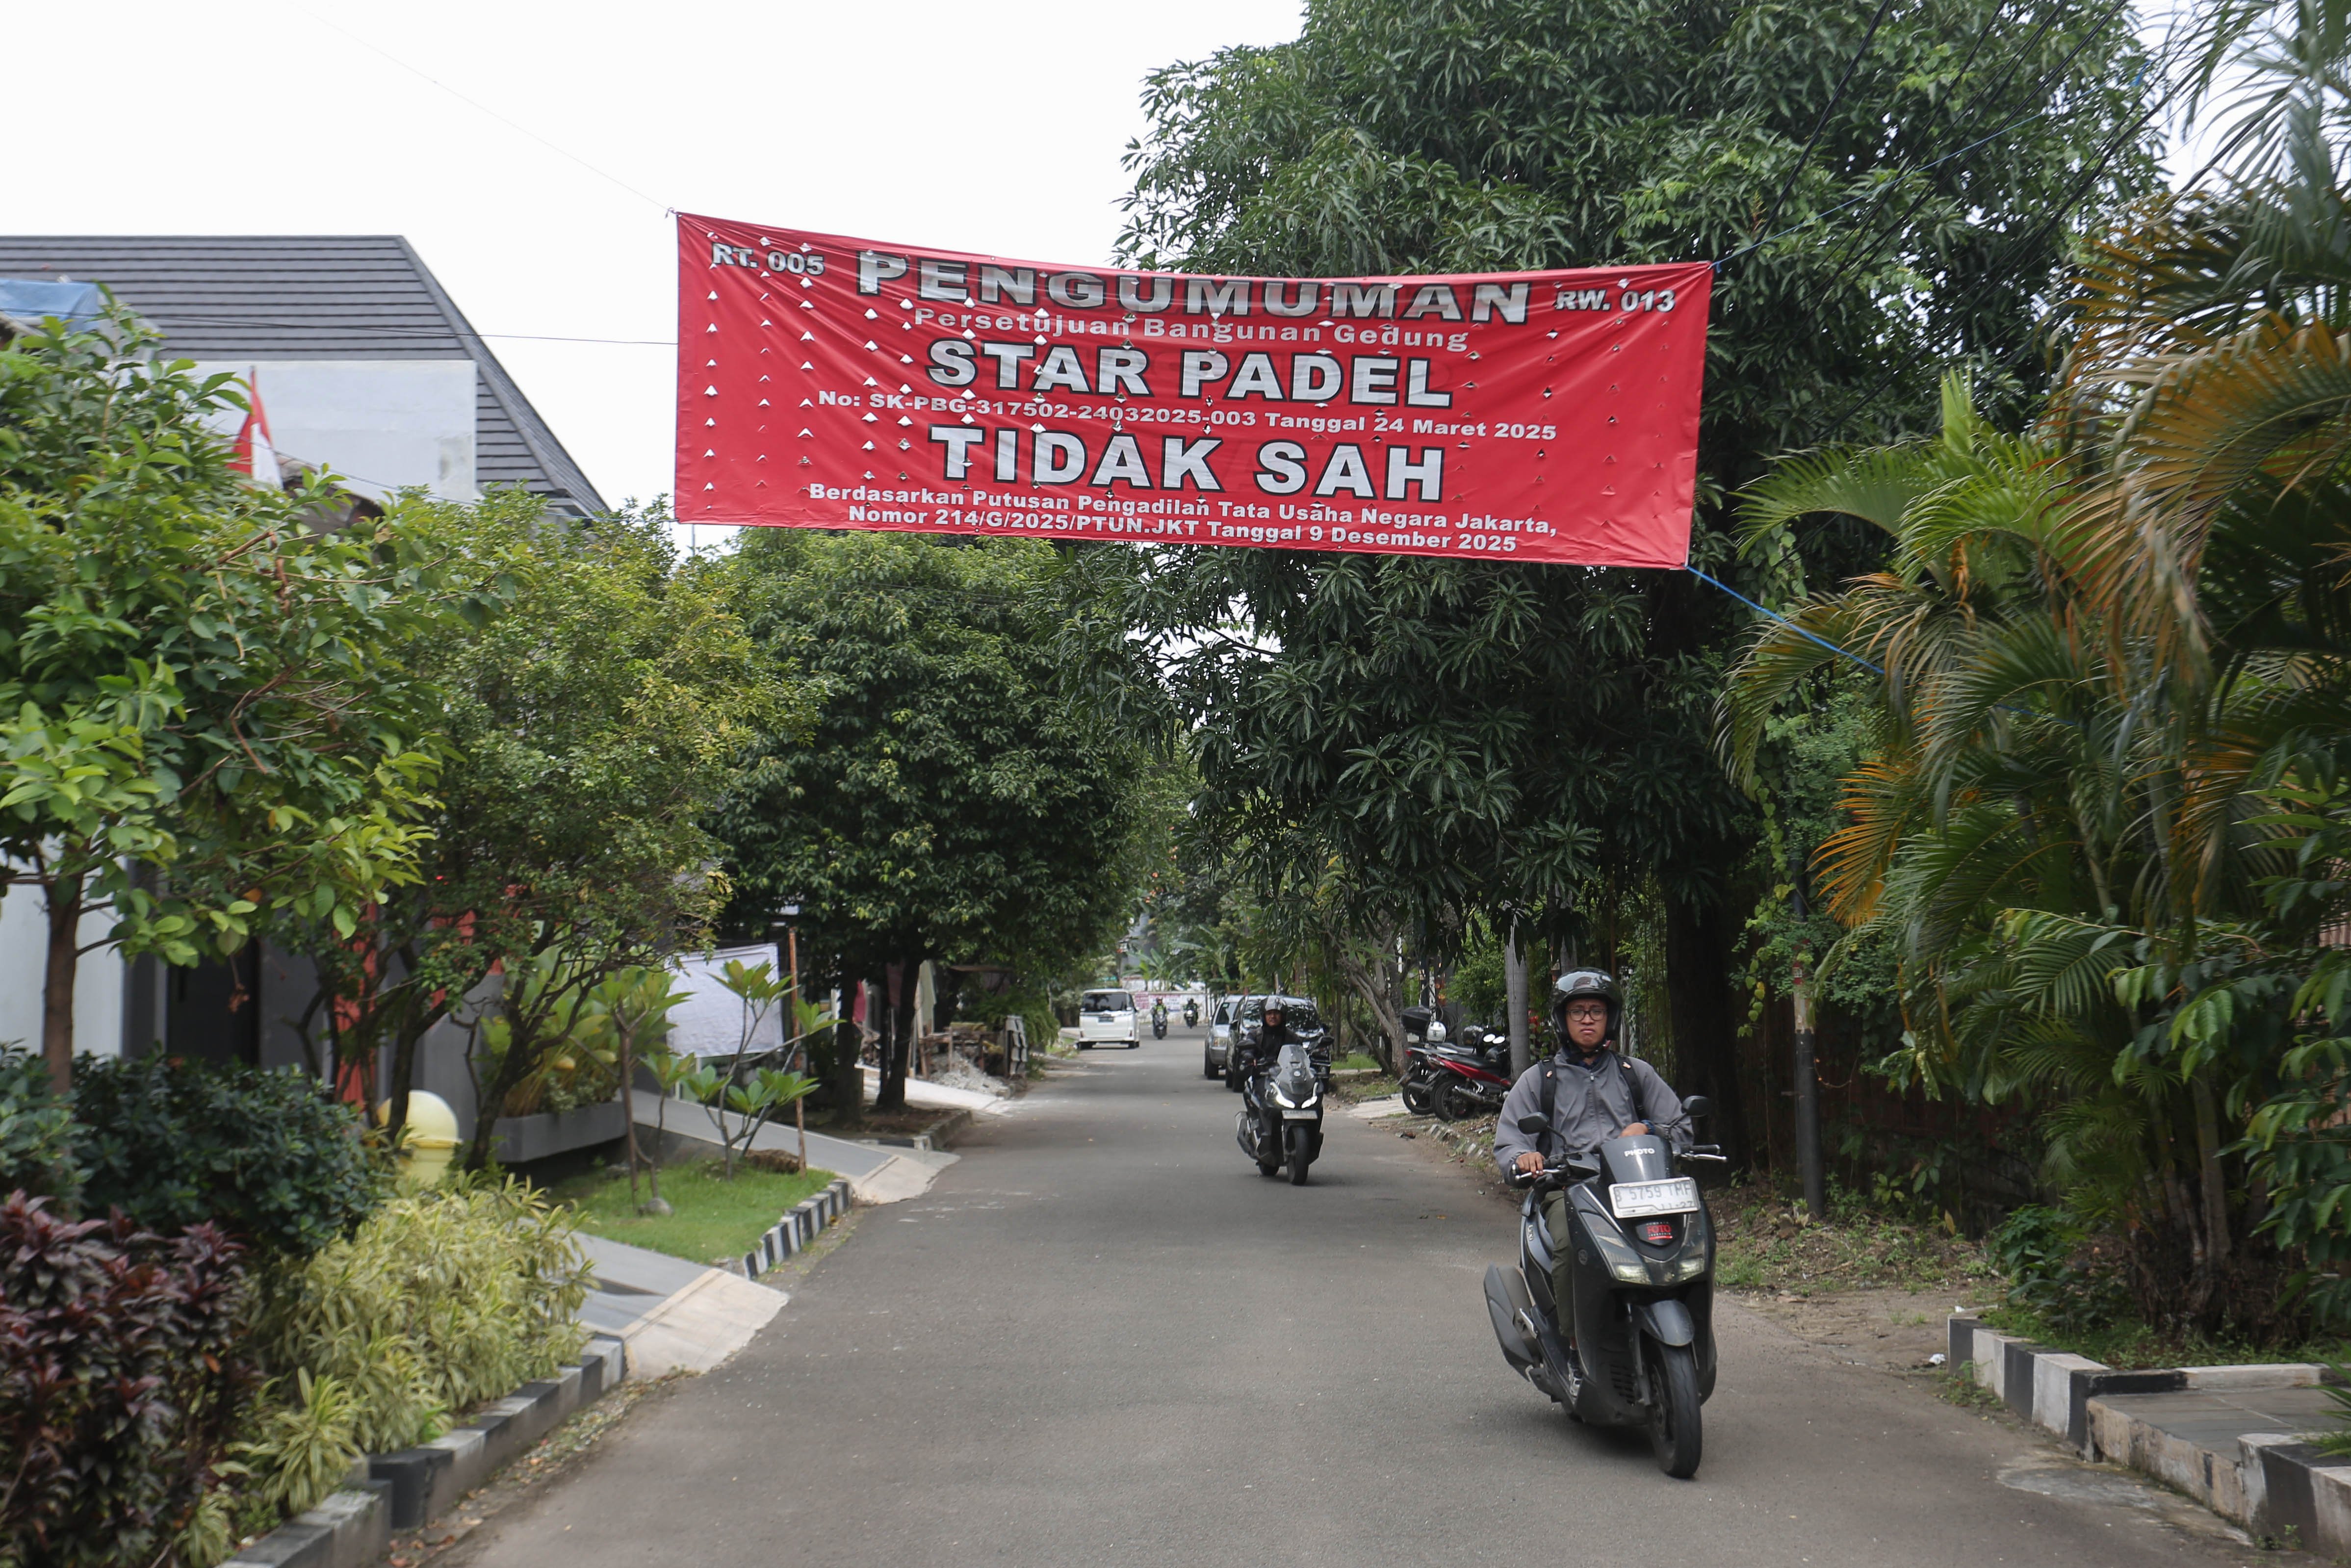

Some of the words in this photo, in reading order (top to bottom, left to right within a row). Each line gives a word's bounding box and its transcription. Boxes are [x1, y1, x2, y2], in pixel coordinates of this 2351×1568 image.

[712, 242, 758, 268] RT.
[767, 251, 825, 276] 005
[857, 251, 1532, 325] PENGUMUMAN
[1555, 289, 1612, 311] RW.
[1620, 288, 1676, 312] 013
[914, 308, 1130, 337] Persetujuan
[1143, 318, 1321, 343] Bangunan
[1333, 324, 1469, 352] Gedung
[925, 337, 1155, 397] STAR
[1178, 348, 1454, 409] PADEL
[818, 390, 861, 407] No:
[869, 392, 1256, 426] SK-PBG-317502-24032025-003
[1264, 412, 1365, 434] Tanggal
[1373, 417, 1404, 433] 24
[1413, 418, 1487, 437] Maret
[1494, 422, 1557, 440] 2025
[927, 423, 1226, 493] TIDAK
[1252, 438, 1446, 503] SAH
[809, 483, 964, 506] Berdasarkan
[972, 489, 1070, 510] Putusan
[1078, 495, 1210, 516] Pengadilan
[1217, 501, 1270, 519] Tata
[1279, 504, 1352, 523] Usaha
[1361, 508, 1447, 530] Negara
[1454, 513, 1557, 538] Jakarta,
[849, 505, 928, 524] Nomor
[934, 509, 1200, 536] 214/G/2025/PTUN.JKT
[1207, 520, 1301, 542] Tanggal
[1309, 525, 1323, 542] 9
[1331, 527, 1452, 549] Desember
[1457, 533, 1517, 552] 2025
[1624, 1148, 1655, 1157] PHOTO
[1628, 1185, 1662, 1200] 5759
[1647, 1224, 1672, 1234] FOTO
